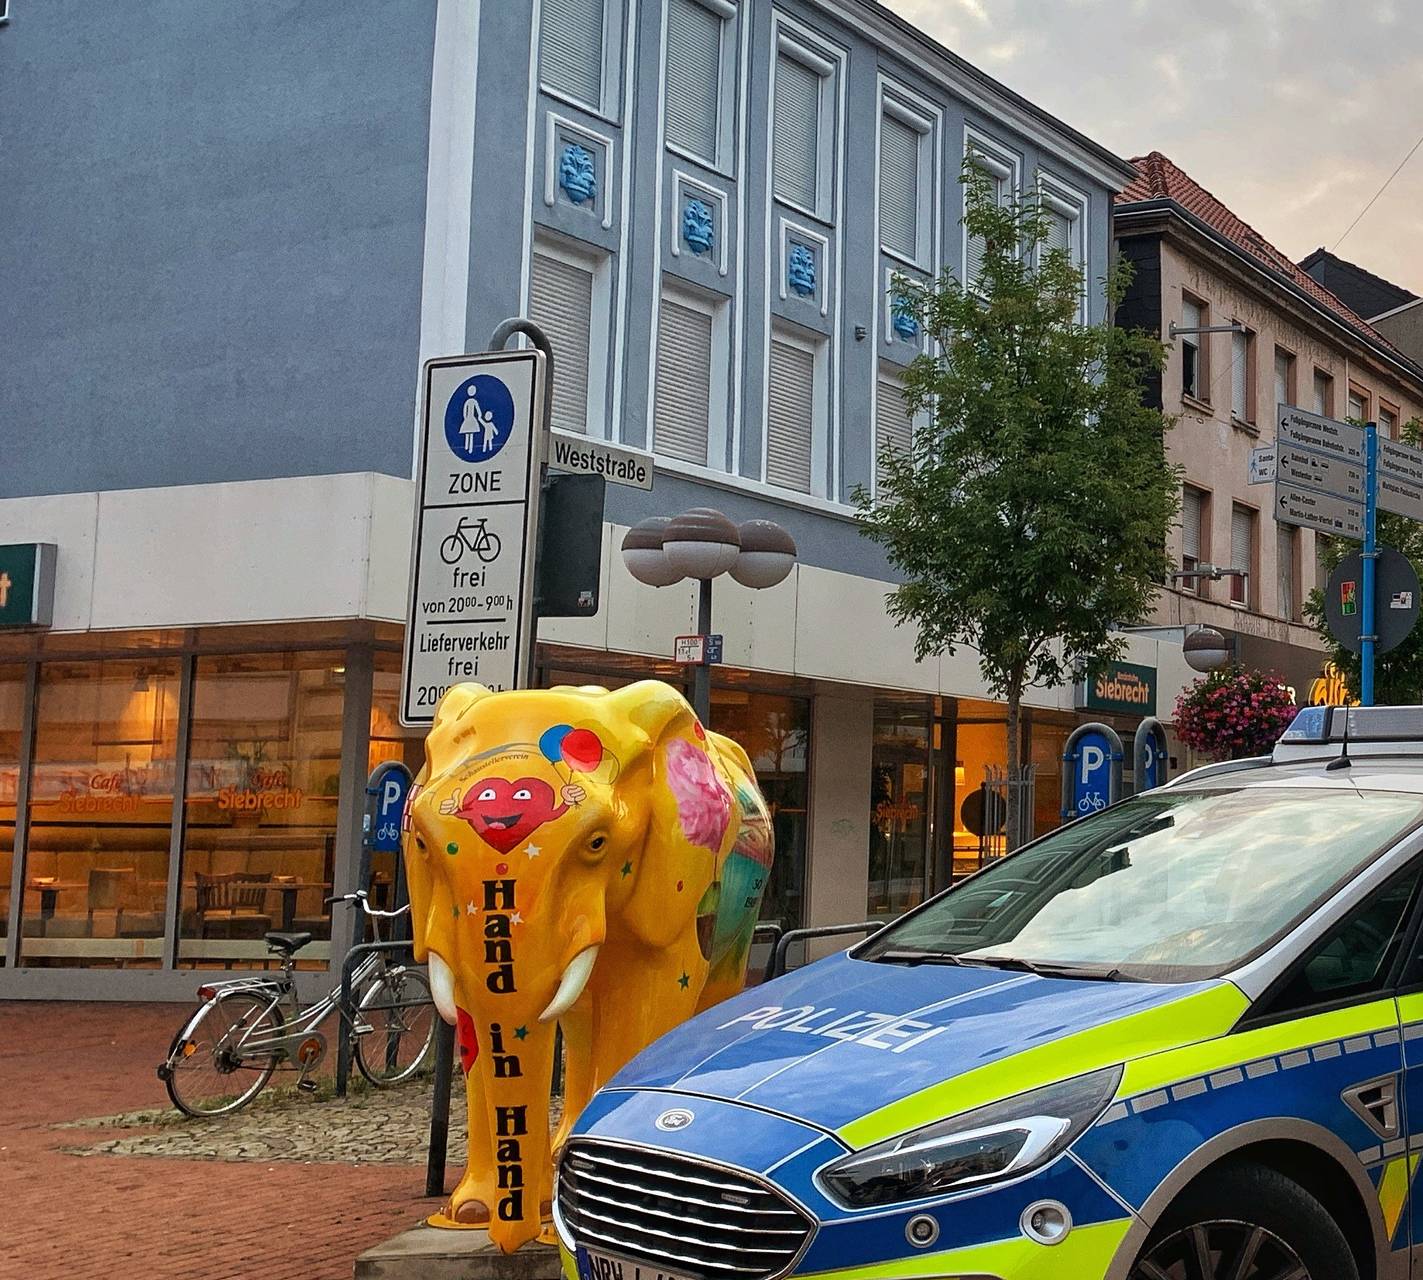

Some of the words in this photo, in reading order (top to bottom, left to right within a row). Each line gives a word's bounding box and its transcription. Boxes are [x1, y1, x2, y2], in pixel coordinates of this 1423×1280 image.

[555, 441, 646, 482] Weststraße
[448, 471, 502, 494] ZONE
[452, 566, 486, 588] frei
[423, 602, 445, 613] von
[420, 631, 510, 652] Lieferverkehr
[448, 656, 479, 676] frei
[1096, 674, 1149, 704] Siebrecht
[1082, 746, 1104, 784] P
[218, 785, 304, 809] Siebrecht
[382, 781, 400, 816] P
[482, 878, 517, 995] Hand
[716, 1005, 948, 1054] POLIZEI
[489, 1022, 523, 1079] in
[495, 1105, 528, 1222] Hand
